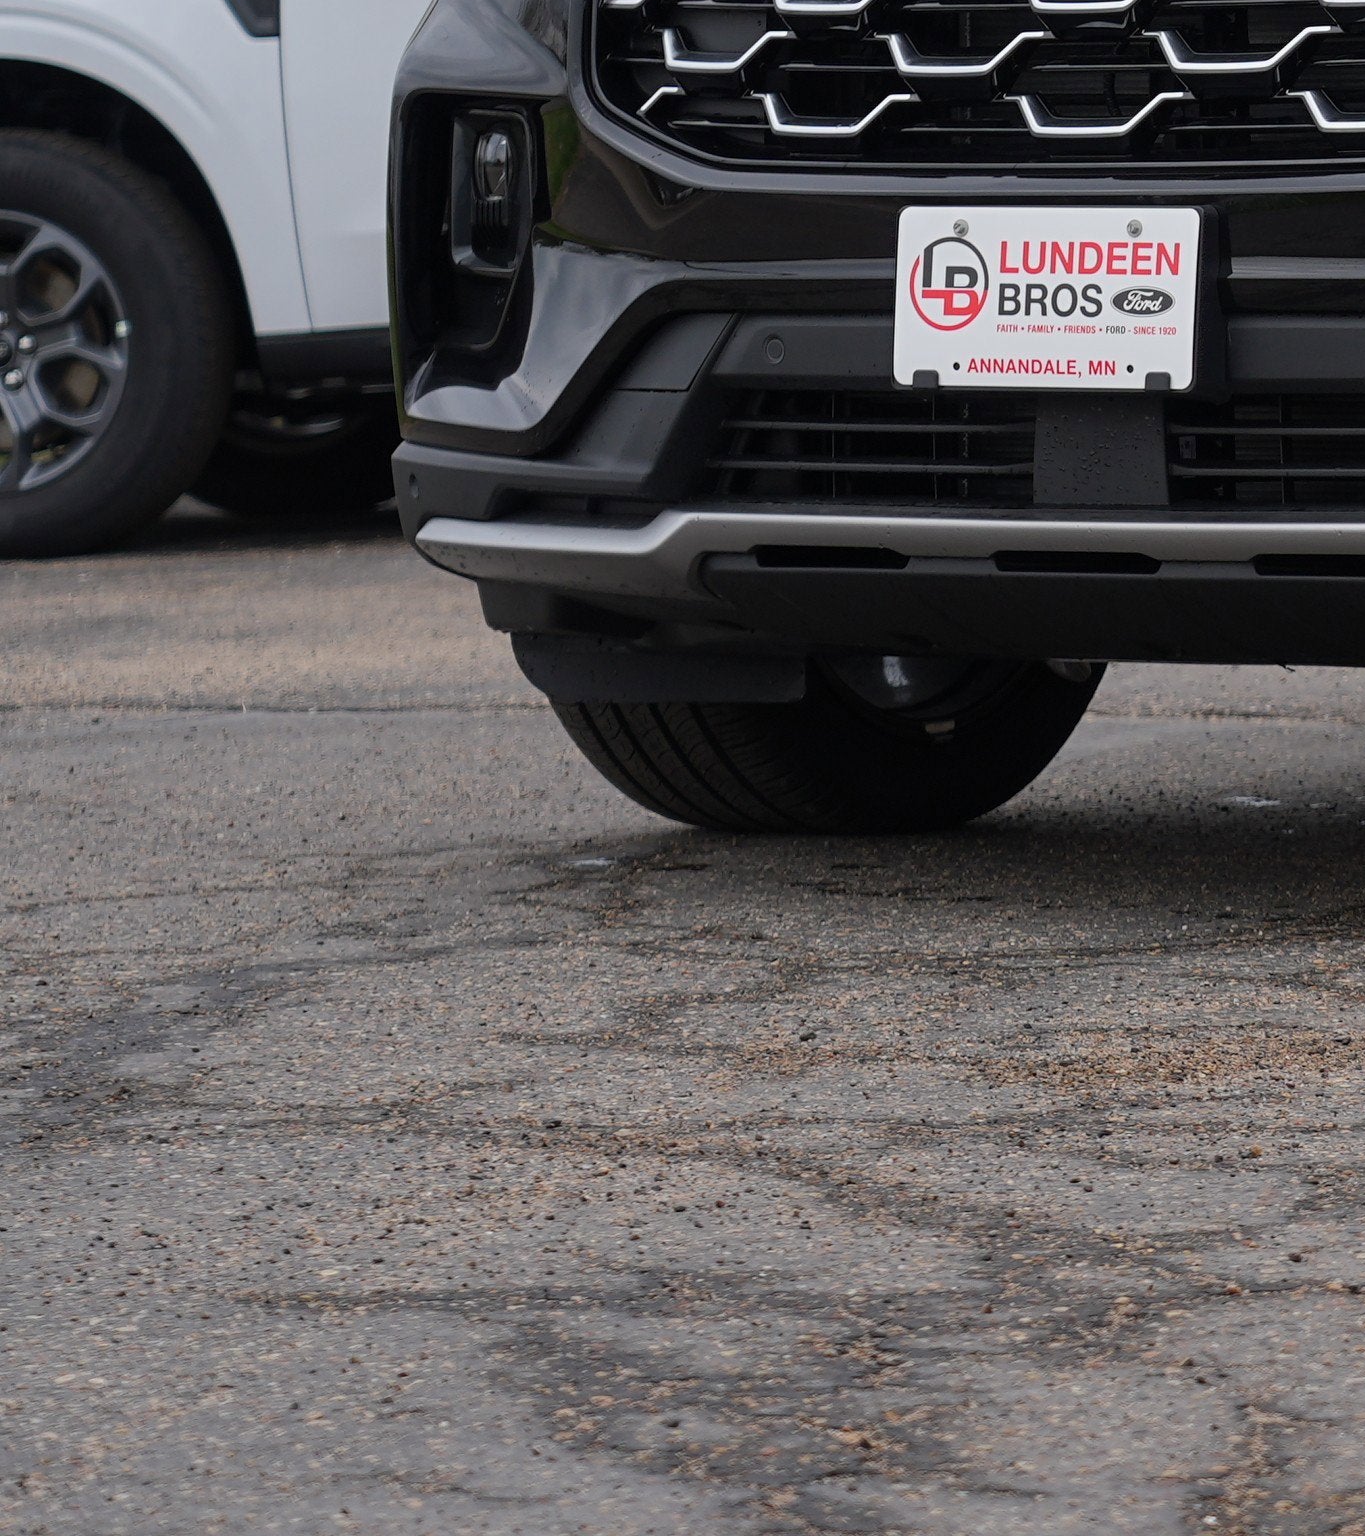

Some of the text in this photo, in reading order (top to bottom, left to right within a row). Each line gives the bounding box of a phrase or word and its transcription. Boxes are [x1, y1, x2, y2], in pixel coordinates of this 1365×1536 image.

[1000, 241, 1181, 275] LUNDEEN
[998, 283, 1103, 318] BROS
[1123, 289, 1162, 312] Ford
[996, 324, 1177, 335] FAITH FAMILY FRIENDS FORD SINCE 1920
[967, 358, 1116, 378] ANNANDALE, MN
